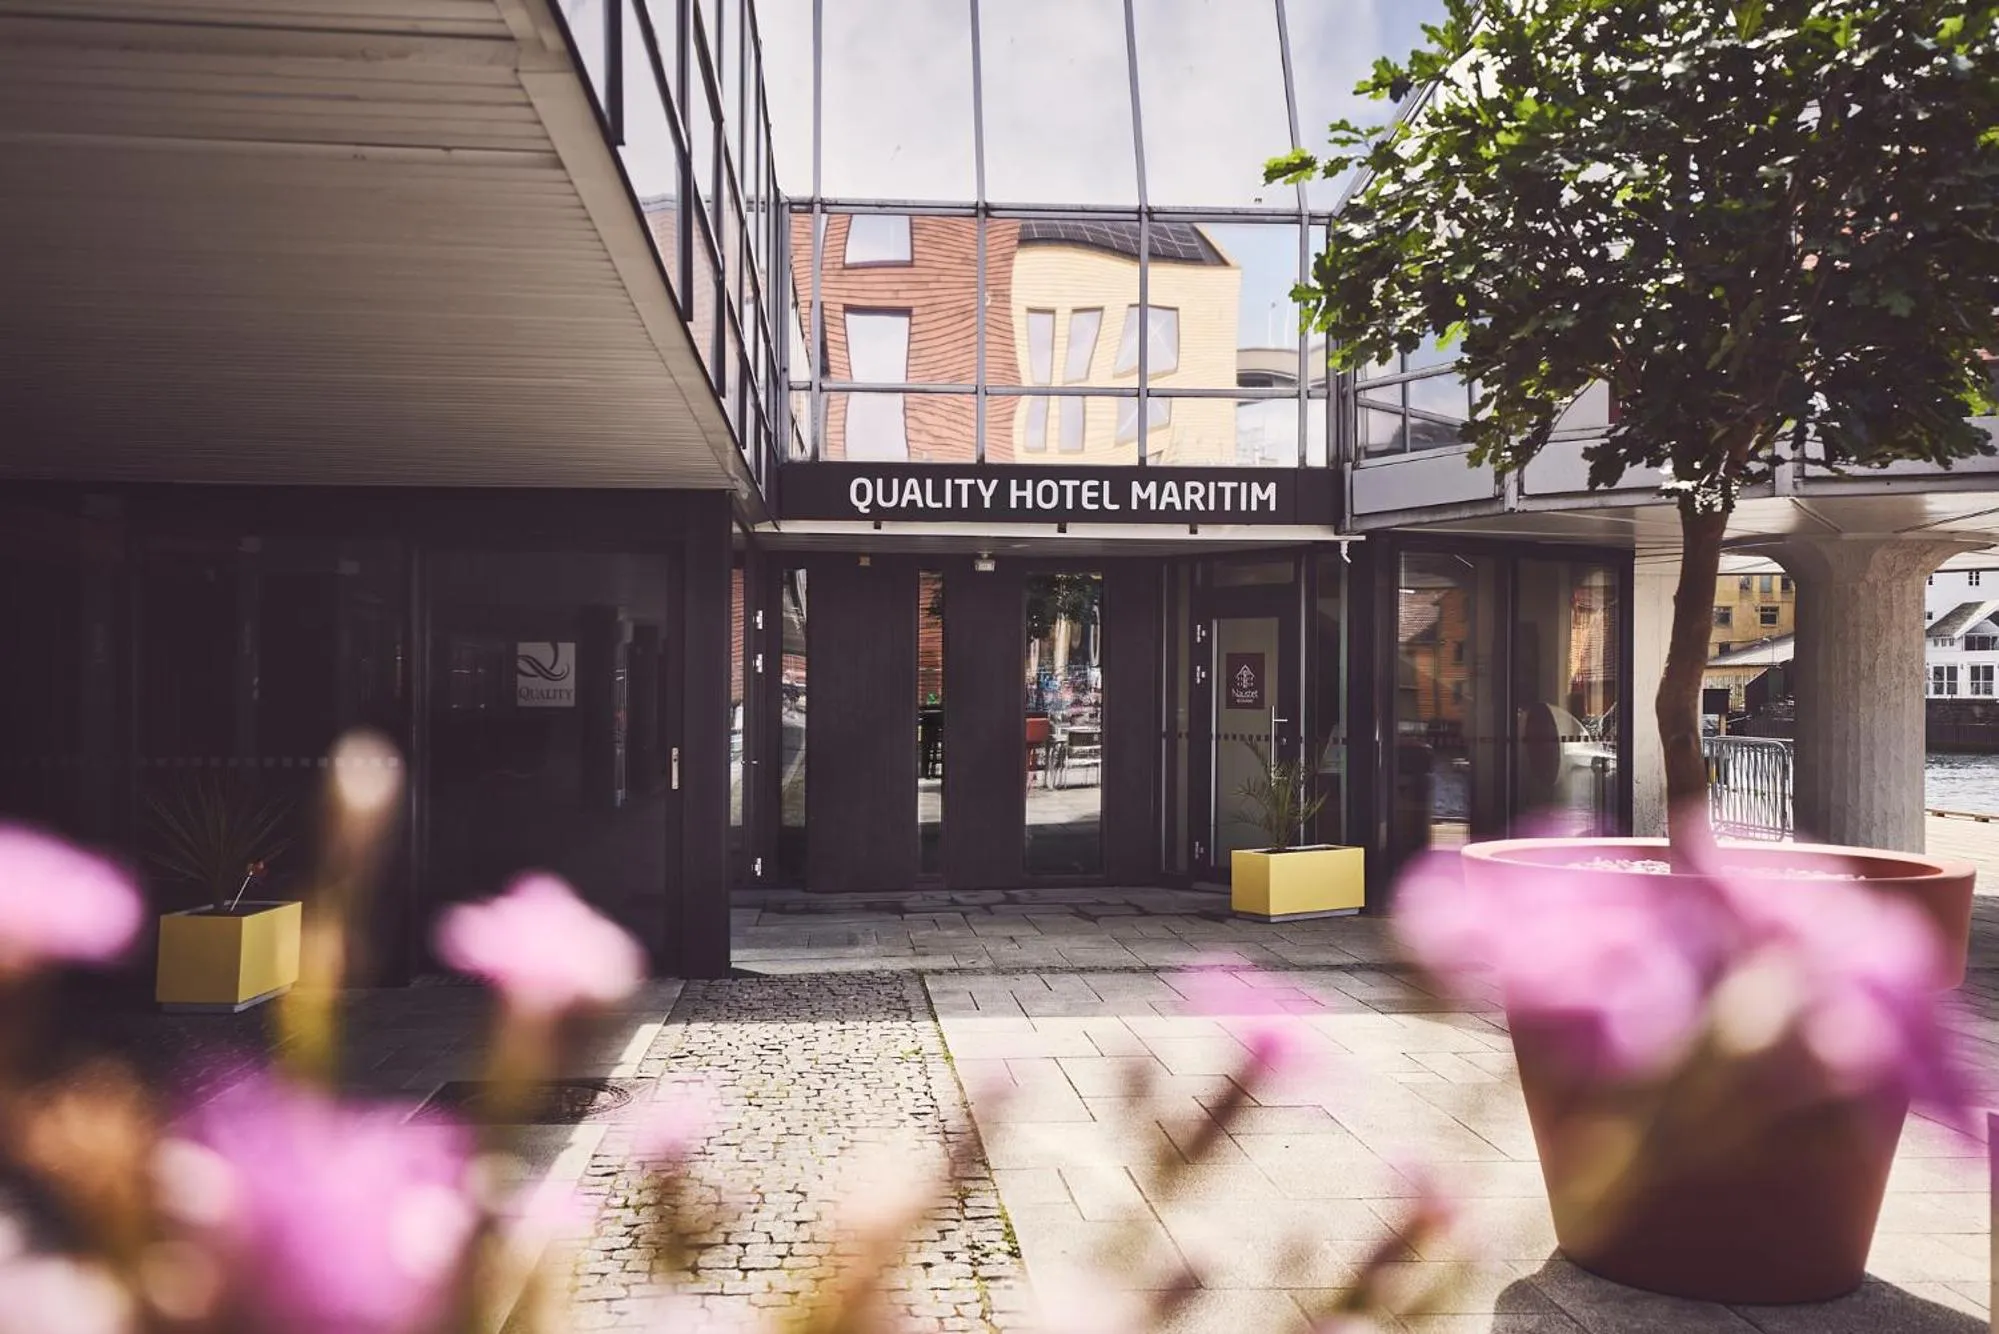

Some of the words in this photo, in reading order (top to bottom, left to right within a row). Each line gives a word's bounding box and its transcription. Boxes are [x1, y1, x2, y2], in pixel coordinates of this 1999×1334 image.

[849, 477, 998, 514] QUALITY
[1009, 479, 1120, 510] HOTEL
[1131, 480, 1277, 512] MARITIM
[518, 687, 573, 701] QUALITY
